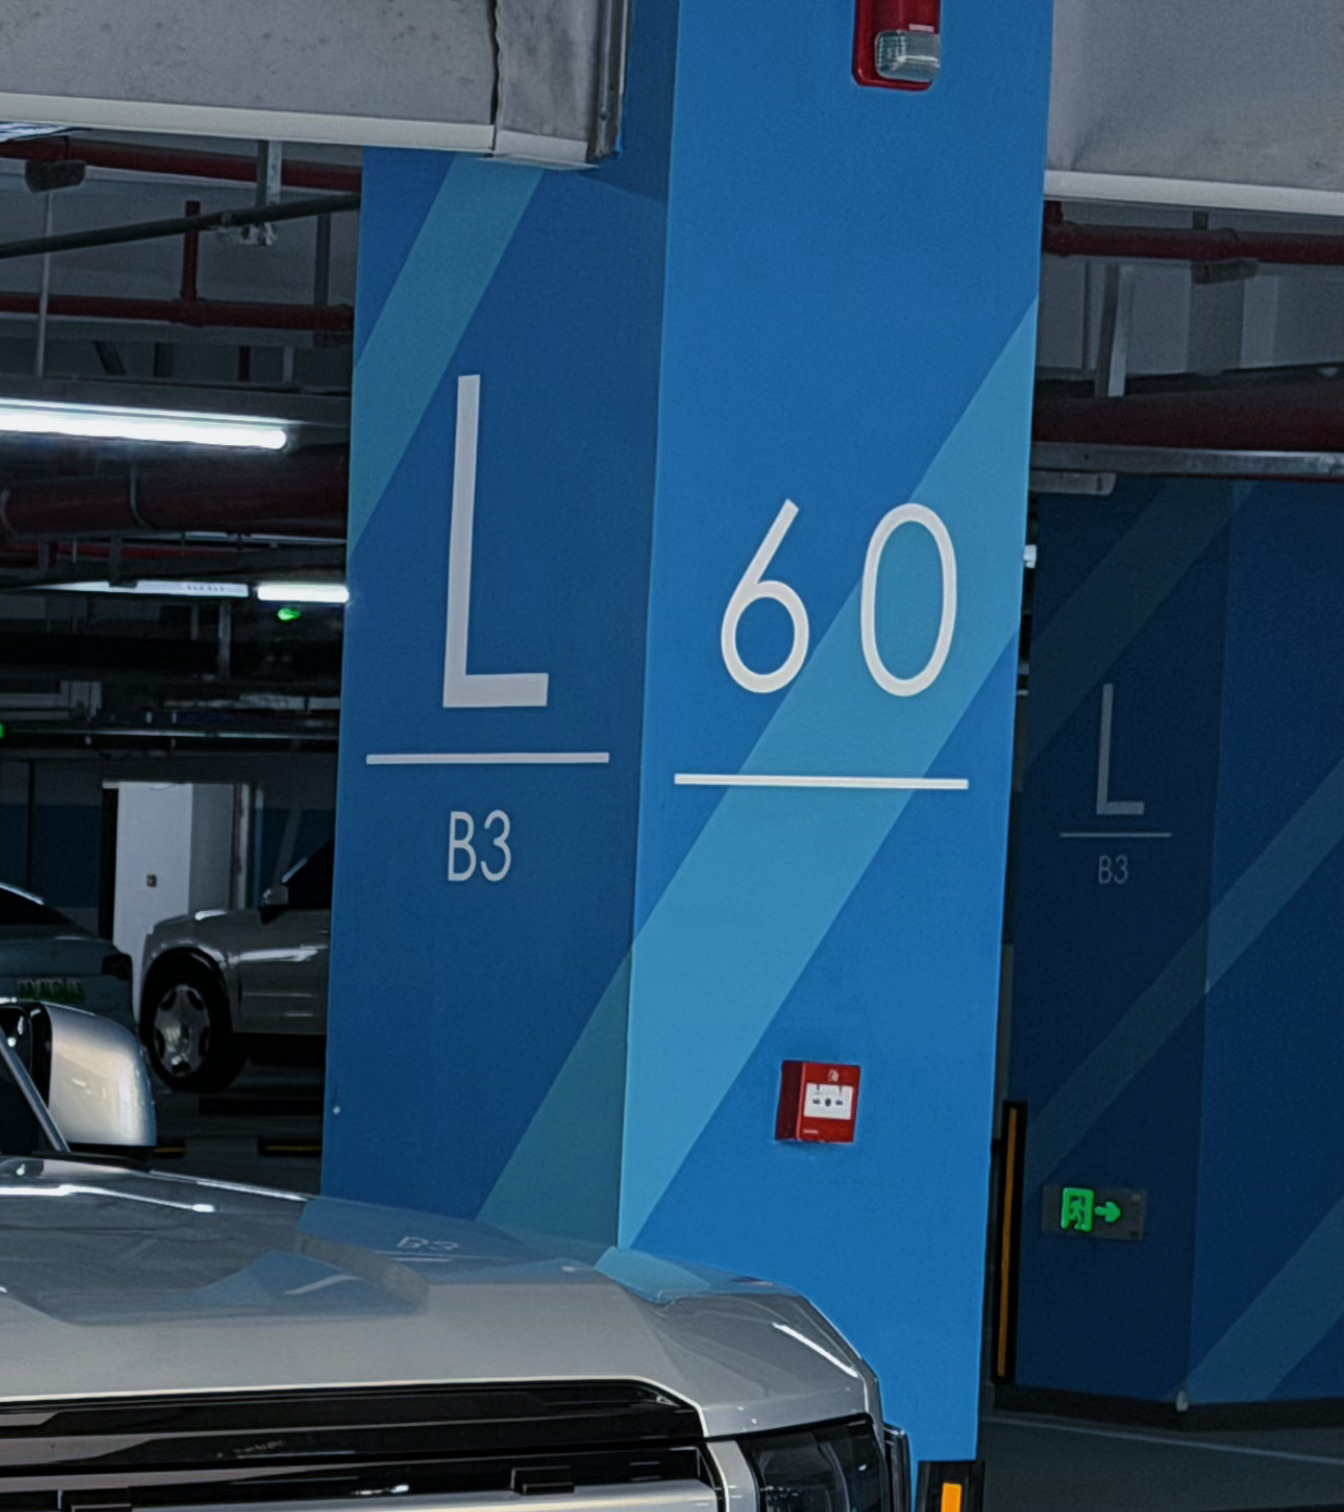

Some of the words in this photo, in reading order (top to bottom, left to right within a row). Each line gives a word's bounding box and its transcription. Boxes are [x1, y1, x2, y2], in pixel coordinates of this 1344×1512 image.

[442, 374, 549, 708] L
[720, 498, 958, 697] 60
[1096, 683, 1144, 815] L
[446, 809, 512, 882] B3
[1098, 855, 1129, 885] B3
